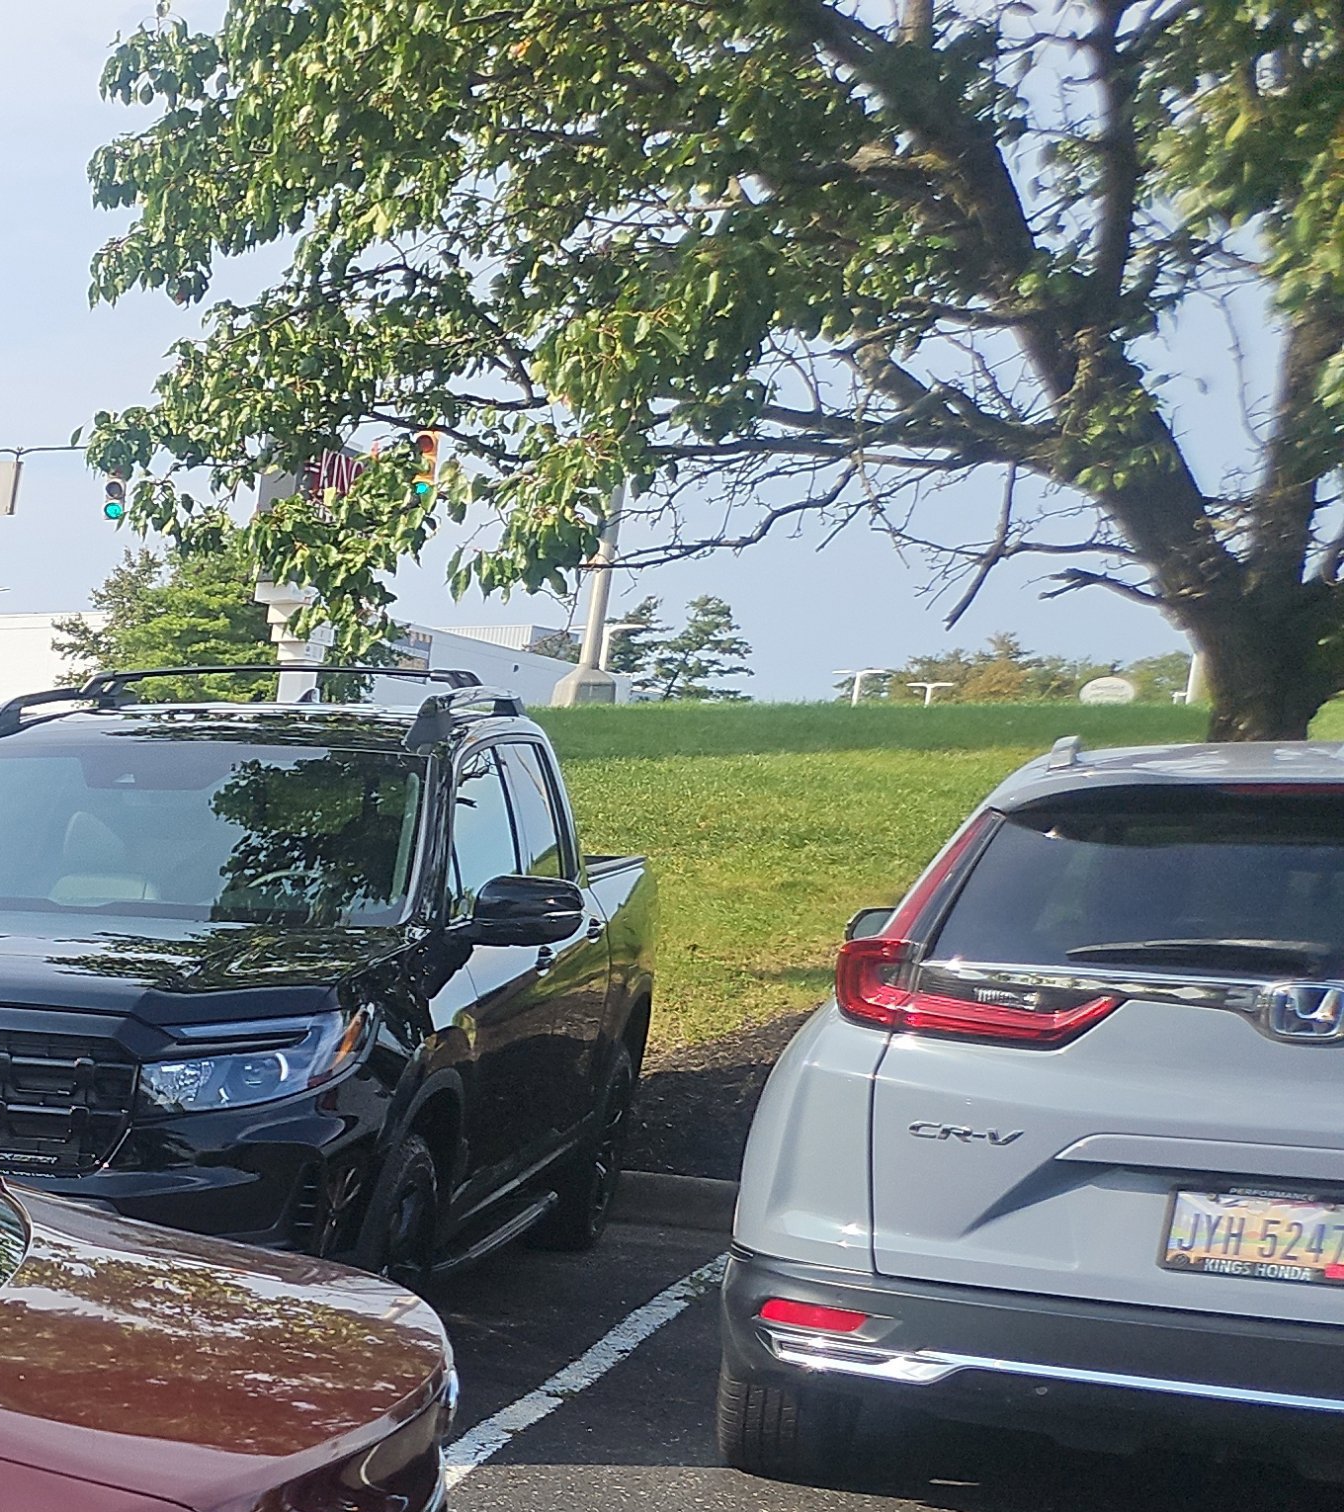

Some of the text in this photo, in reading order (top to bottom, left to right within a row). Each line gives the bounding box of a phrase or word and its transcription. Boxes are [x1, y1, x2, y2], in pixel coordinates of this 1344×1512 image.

[908, 1120, 1024, 1146] CR-V
[1177, 1213, 1246, 1256] JYH
[1204, 1258, 1312, 1282] KINGS HONDA
